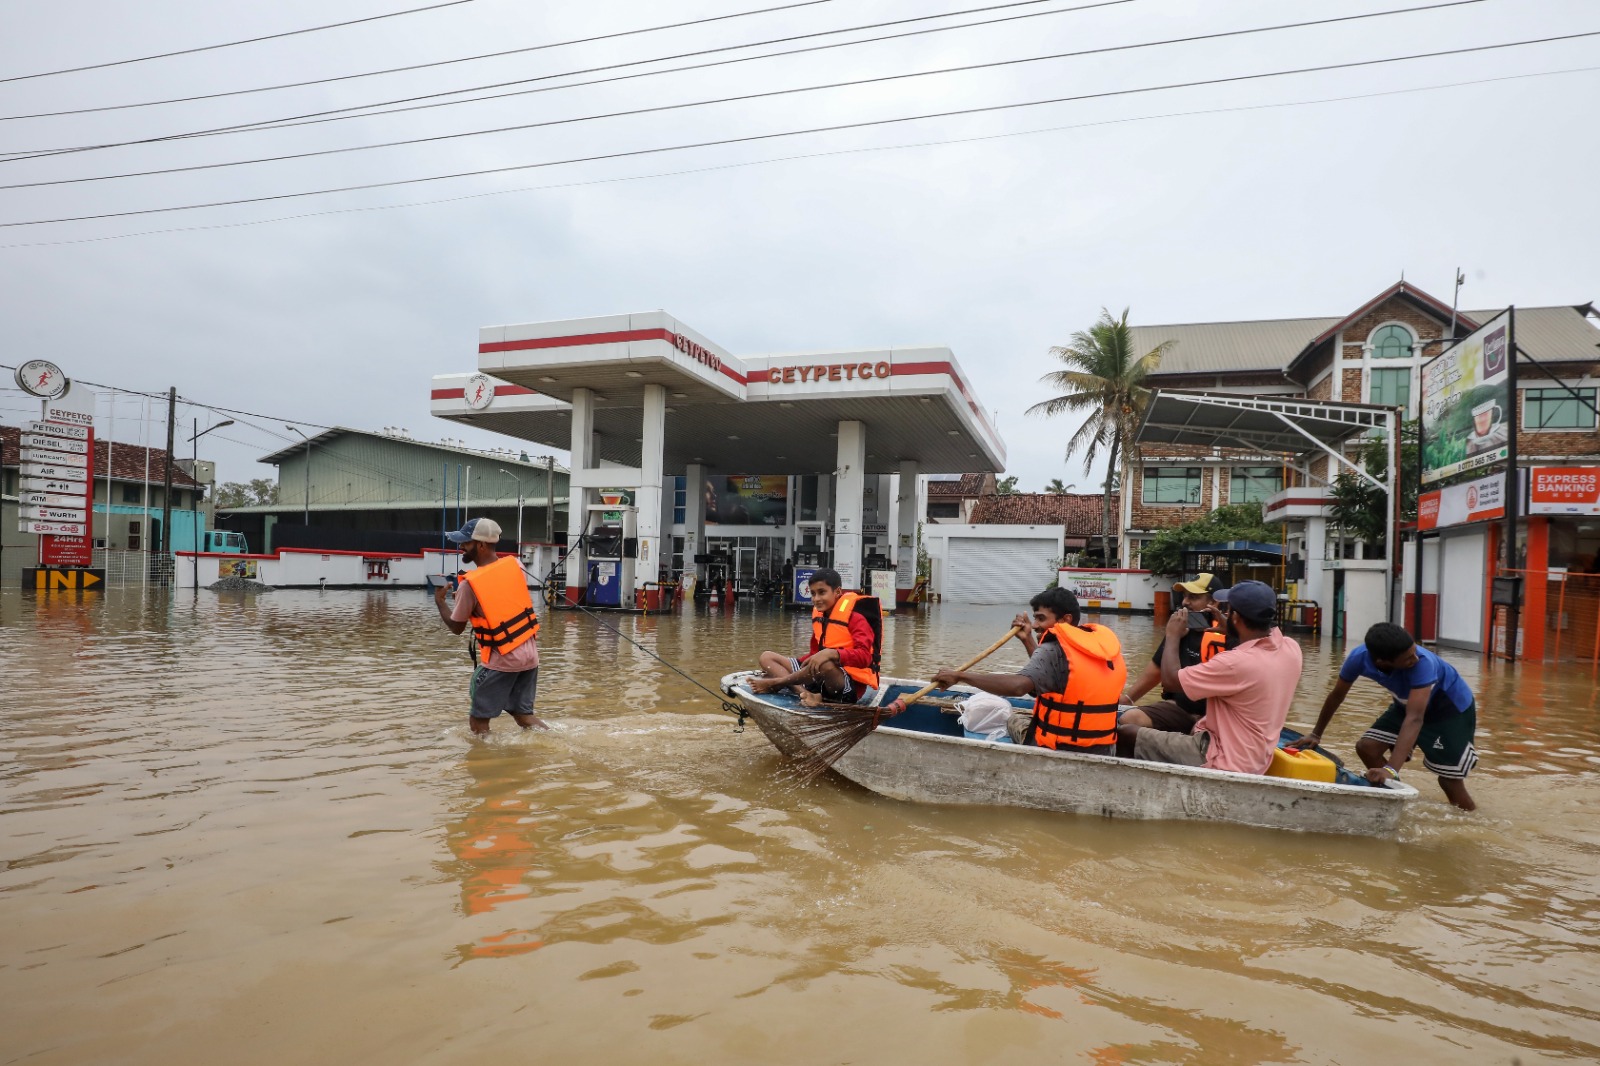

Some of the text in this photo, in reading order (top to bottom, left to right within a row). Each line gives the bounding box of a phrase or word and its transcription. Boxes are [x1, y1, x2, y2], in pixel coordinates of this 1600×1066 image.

[674, 333, 721, 371] CEYPETCO
[767, 361, 891, 383] CEYPETCO
[50, 409, 93, 421] CEYPETCO
[32, 424, 66, 434] PETROL
[32, 438, 62, 448] DIESEL
[32, 453, 66, 462] LUBRICANTS
[1537, 474, 1597, 484] EXPRESS
[1537, 484, 1596, 492] BANKING
[53, 535, 84, 543] 24Hrs
[36, 570, 77, 588] IN
